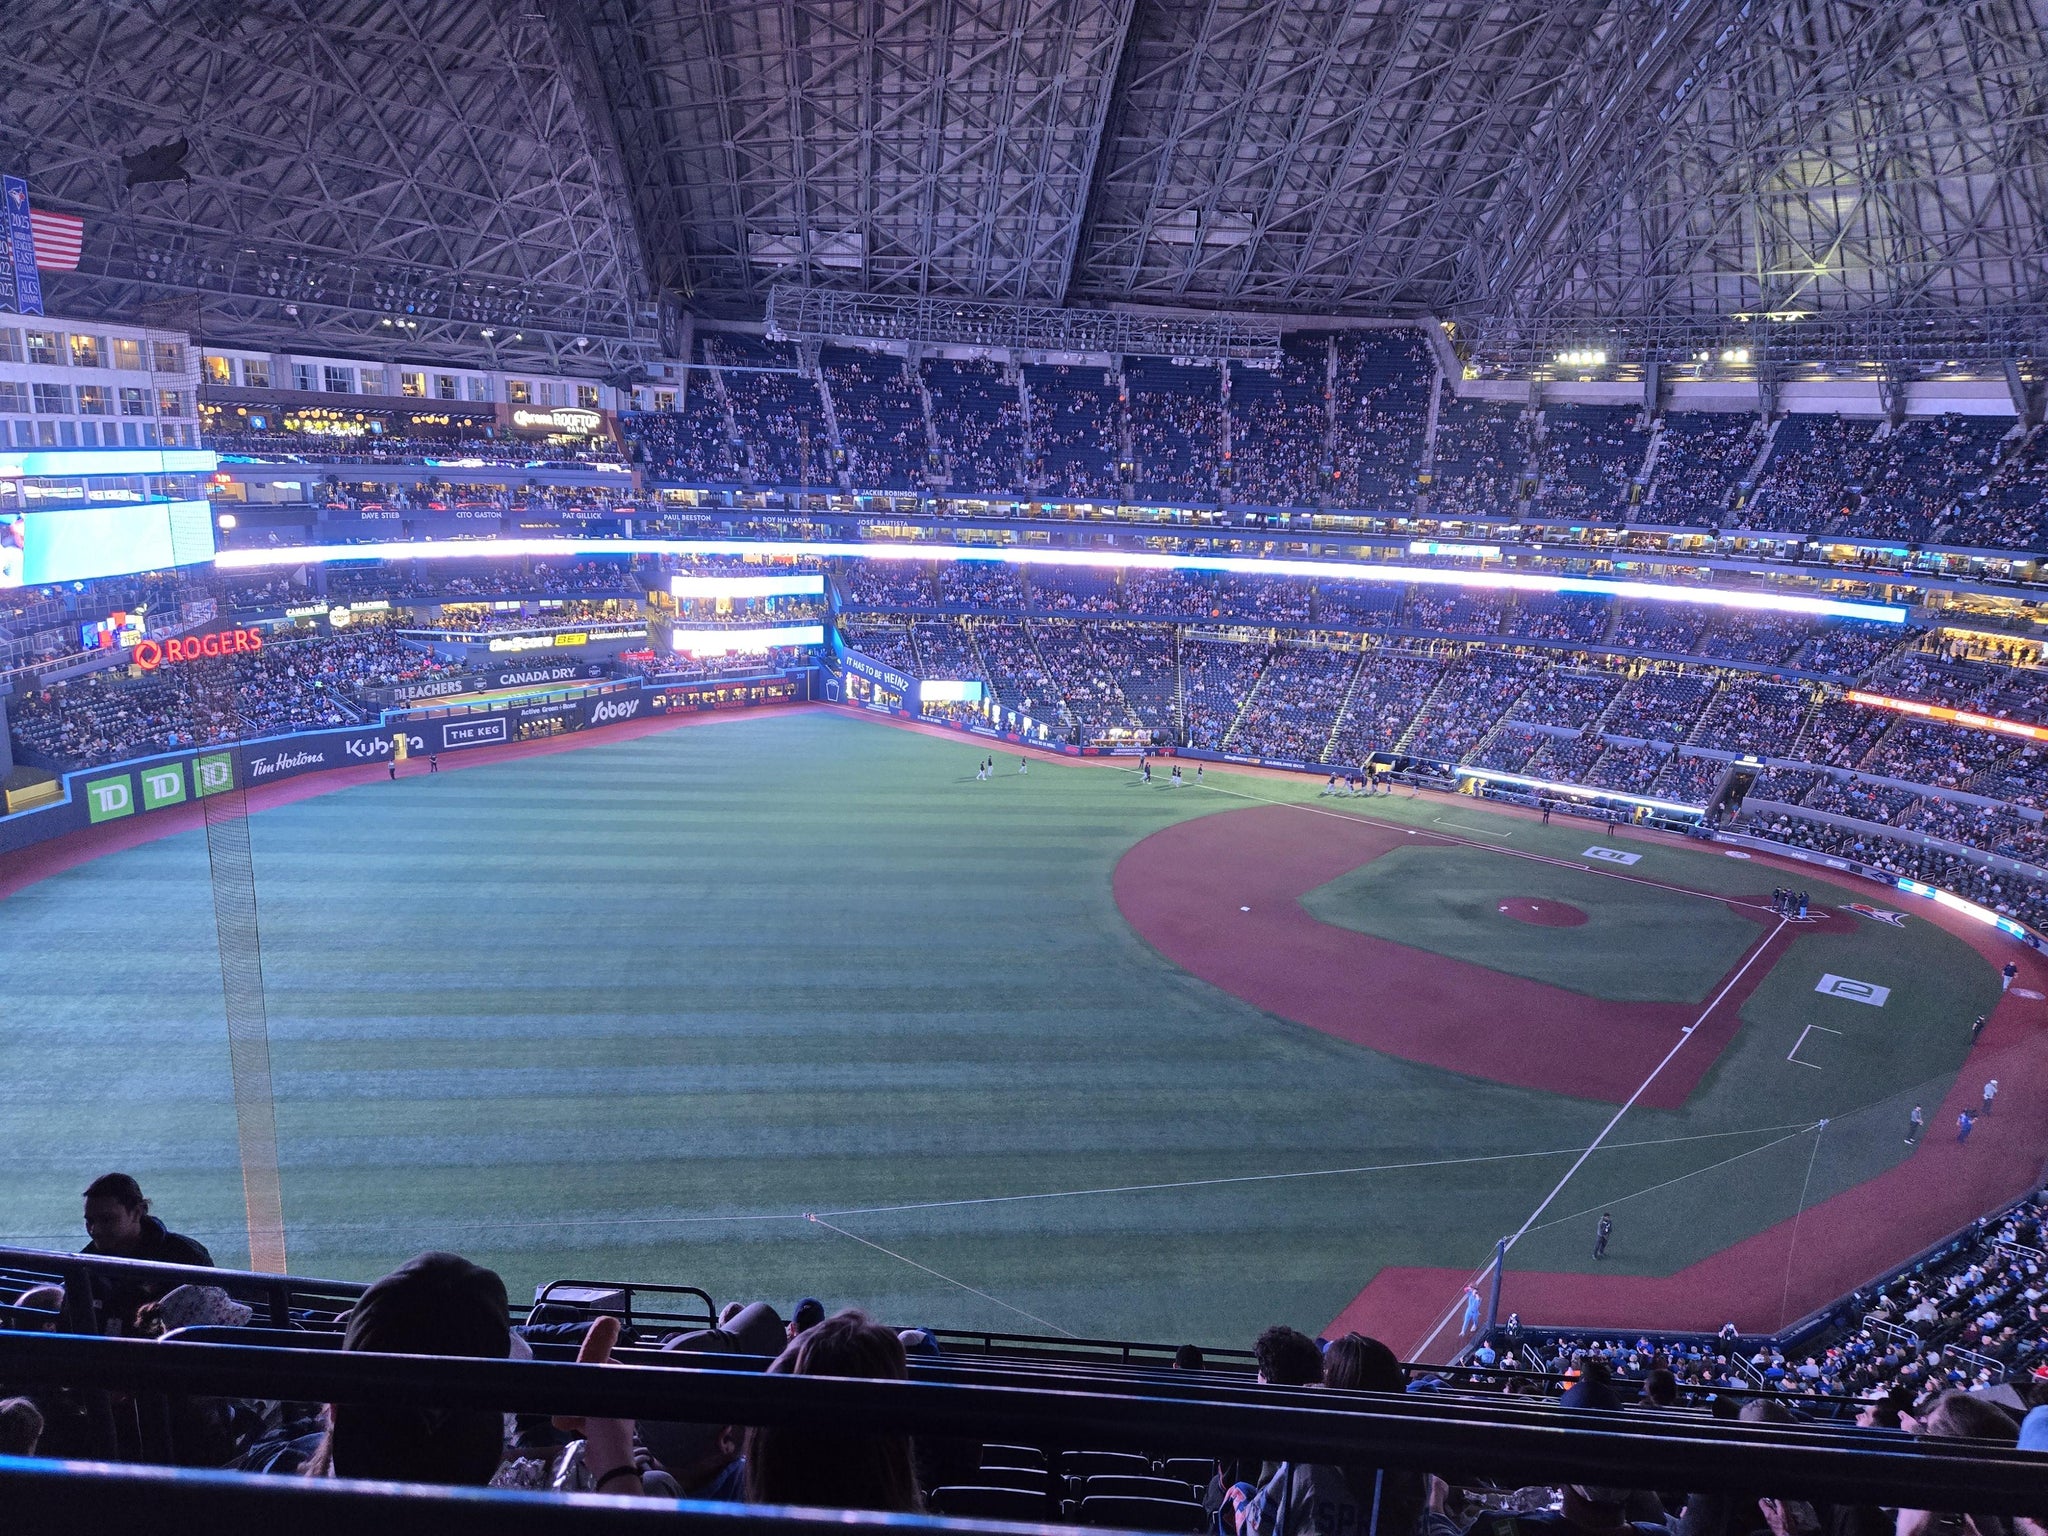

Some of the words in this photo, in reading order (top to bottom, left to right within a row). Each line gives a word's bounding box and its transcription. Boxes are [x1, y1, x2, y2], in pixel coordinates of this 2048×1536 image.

[11, 212, 30, 229] 2025
[16, 250, 34, 265] EAST
[553, 413, 600, 428] ROOFTOP
[861, 489, 883, 497] JACKIE
[884, 490, 918, 498] ROBINSON
[361, 512, 379, 520] DAVE
[381, 512, 400, 520] STIEB
[456, 511, 473, 519] CITO
[474, 511, 502, 519] GASTON
[562, 512, 576, 520] PAT
[576, 512, 602, 520] GILLICK
[681, 514, 711, 522] BEESTON
[762, 516, 776, 524] ROY
[777, 517, 811, 525] HALLADAY
[876, 519, 908, 528] BAUTISTA
[166, 627, 262, 662] ROGERS
[556, 634, 586, 645] BET
[846, 657, 853, 666] IT
[852, 660, 865, 672] HAS
[865, 665, 874, 676] TO
[874, 669, 883, 680] BE
[883, 672, 909, 692] HEINZ
[394, 680, 463, 701] BLEACHERS
[500, 671, 550, 685] CANADA
[521, 708, 540, 716] Active
[591, 699, 640, 724] Sobeys
[451, 731, 476, 739] THE
[479, 726, 500, 736] KEG
[345, 736, 424, 757] Kuba
[251, 757, 275, 777] Tim
[275, 751, 324, 773] Hortons
[198, 762, 228, 787] TD
[146, 773, 180, 799] TD
[92, 784, 128, 812] TD
